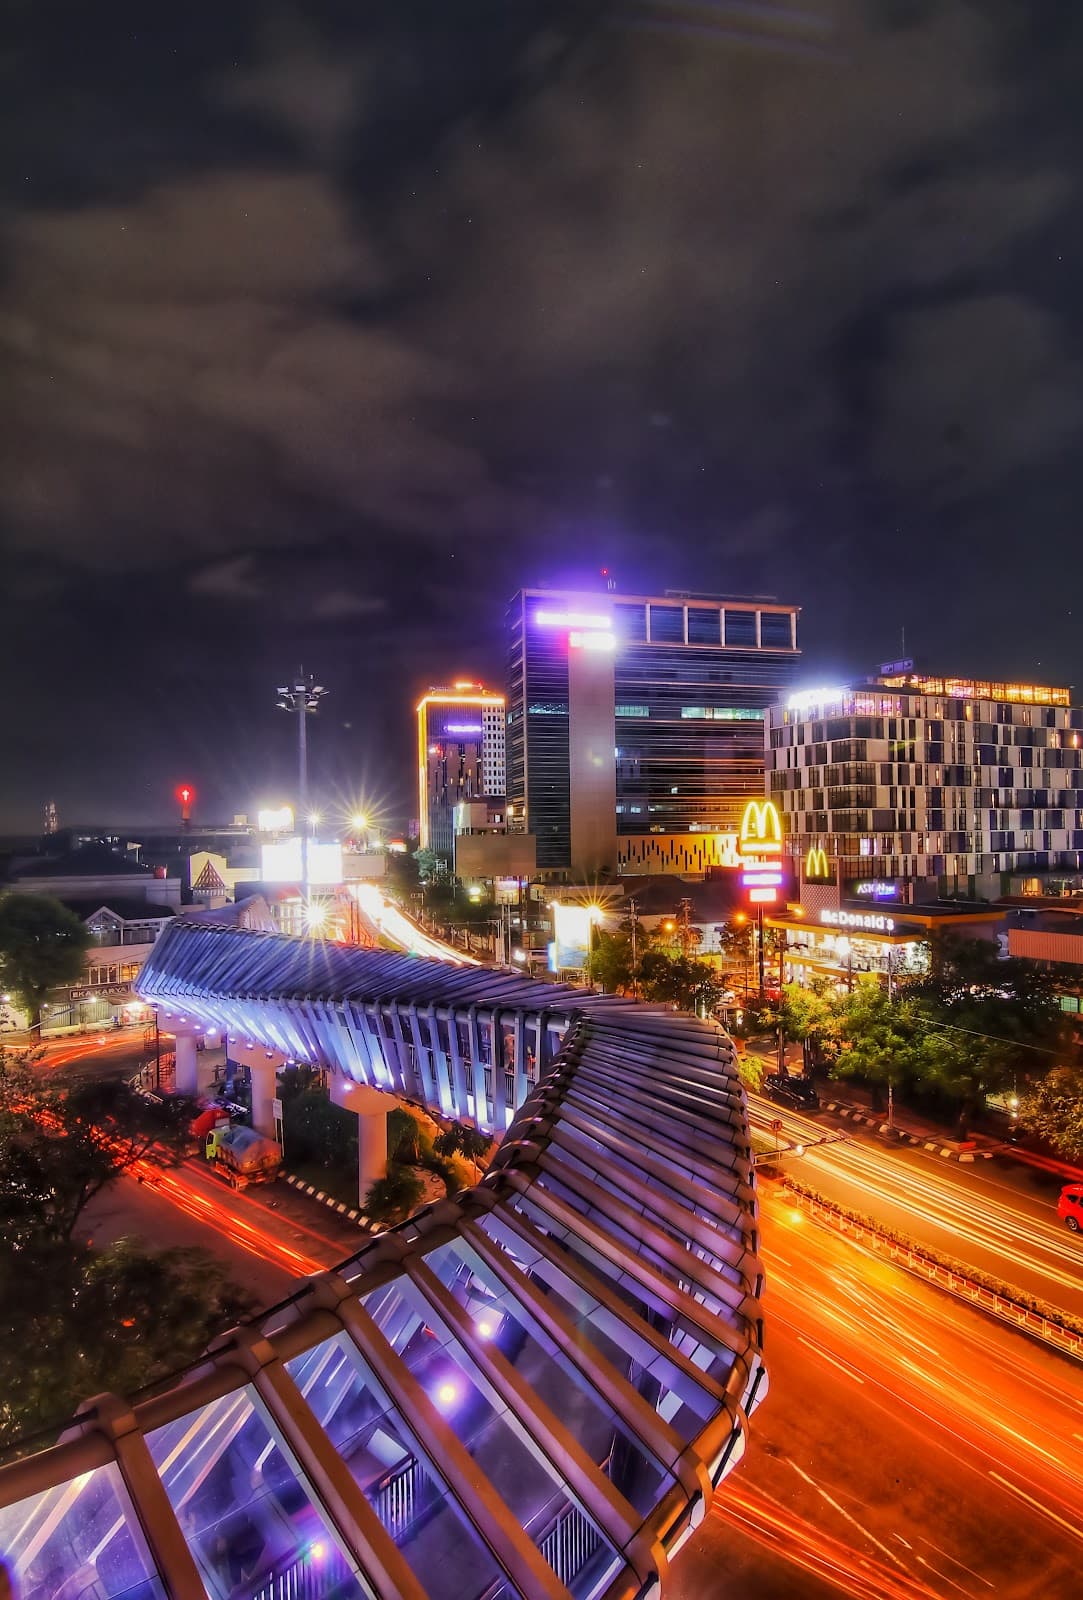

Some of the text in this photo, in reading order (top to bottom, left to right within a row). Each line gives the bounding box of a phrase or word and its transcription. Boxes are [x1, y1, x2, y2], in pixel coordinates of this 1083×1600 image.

[740, 801, 782, 841] M
[806, 848, 829, 878] M
[820, 909, 895, 931] McDonald's
[72, 986, 127, 998] EKA KARYA
